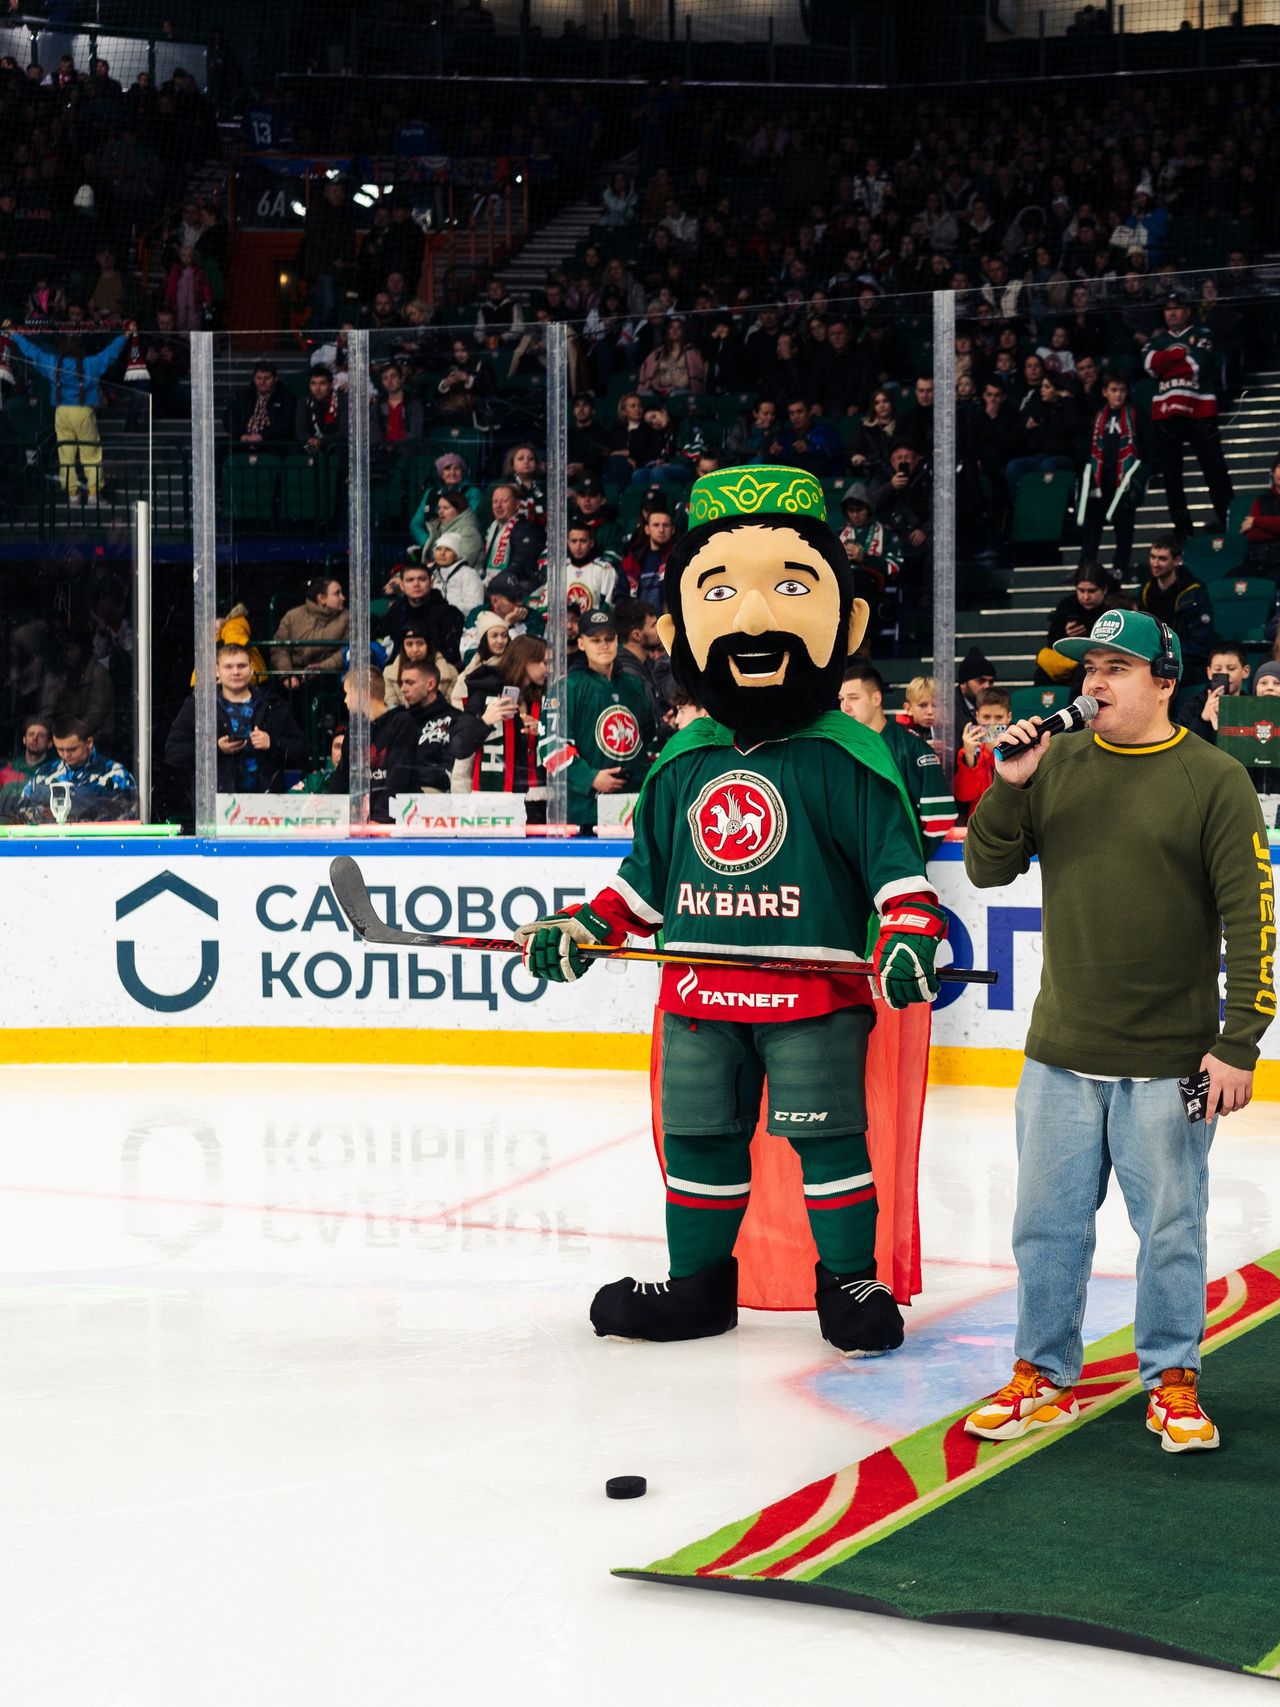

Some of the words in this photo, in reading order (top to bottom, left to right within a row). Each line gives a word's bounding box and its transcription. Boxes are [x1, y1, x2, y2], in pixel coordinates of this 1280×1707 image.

[257, 189, 286, 218] 6A
[421, 816, 515, 829] TATNEFT
[706, 856, 762, 872] ТАТАРСТАН
[700, 883, 769, 892] KAZAN
[589, 914, 608, 930] TRUE
[880, 913, 931, 929] UE
[261, 951, 548, 1011] КОЛЬЦО
[698, 990, 799, 1008] TATNEFT
[774, 1110, 828, 1122] CCM
